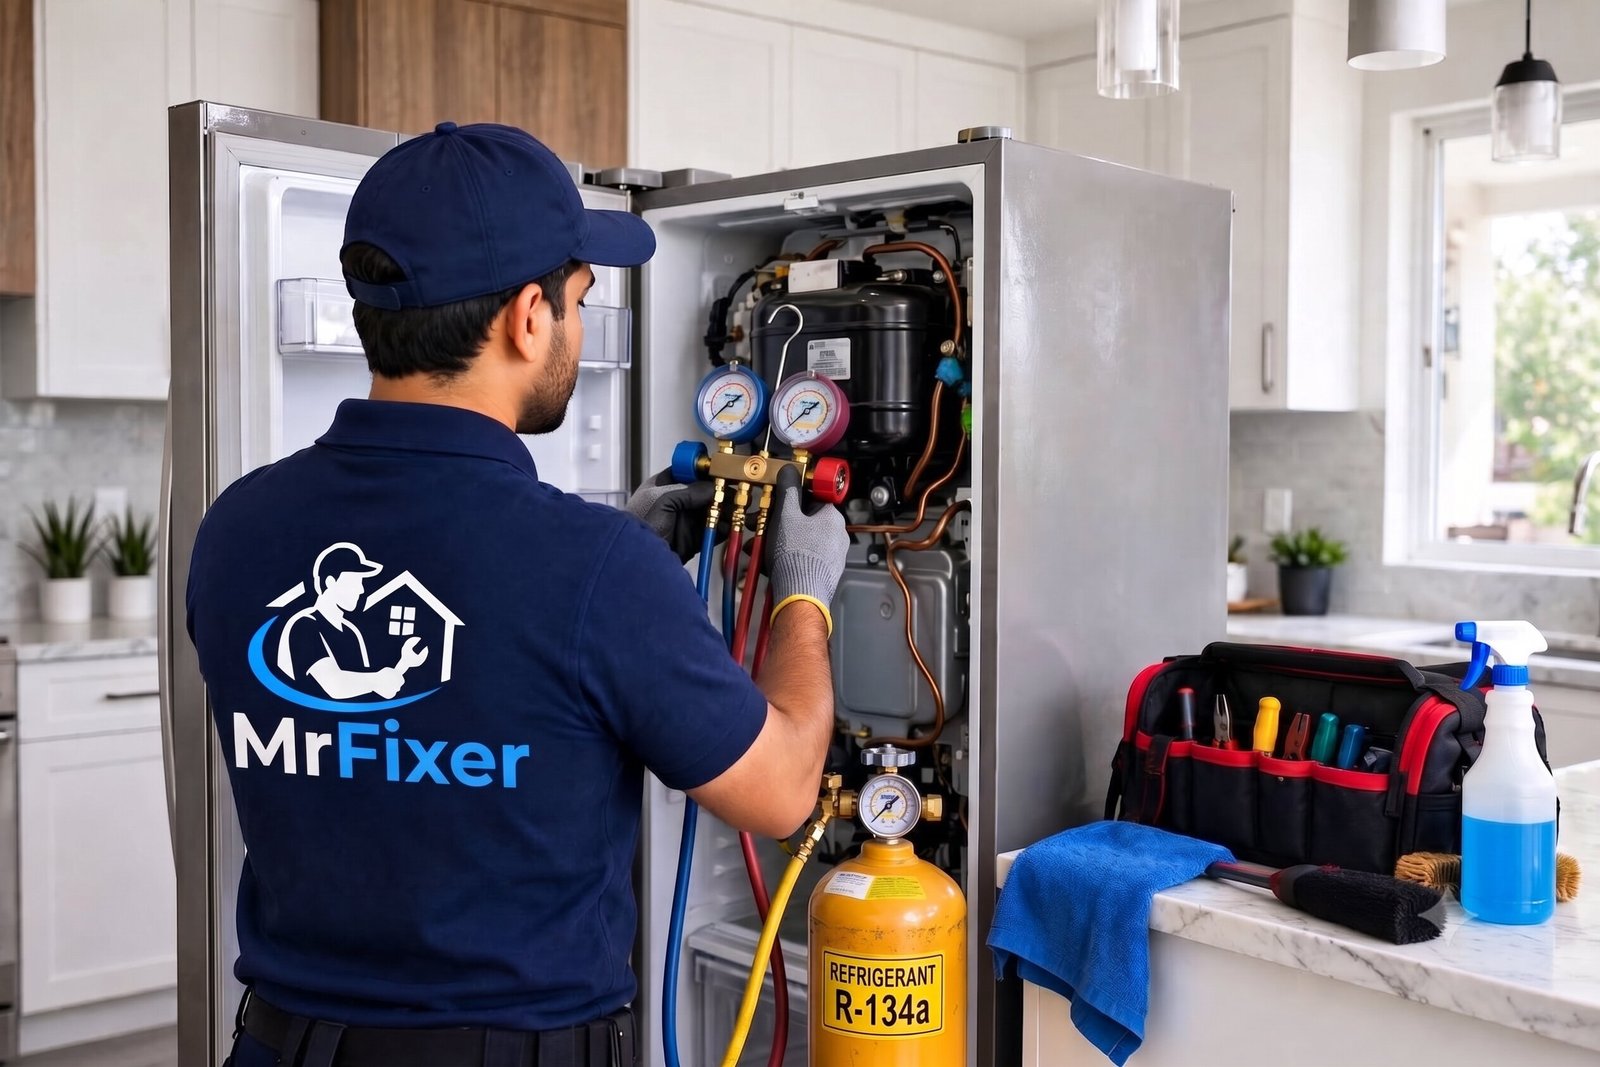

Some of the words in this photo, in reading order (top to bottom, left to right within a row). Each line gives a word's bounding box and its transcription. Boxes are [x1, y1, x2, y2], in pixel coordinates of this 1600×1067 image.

[233, 712, 530, 788] MrFixer
[830, 961, 936, 988] REFRIGERANT
[835, 988, 930, 1027] R-134a
